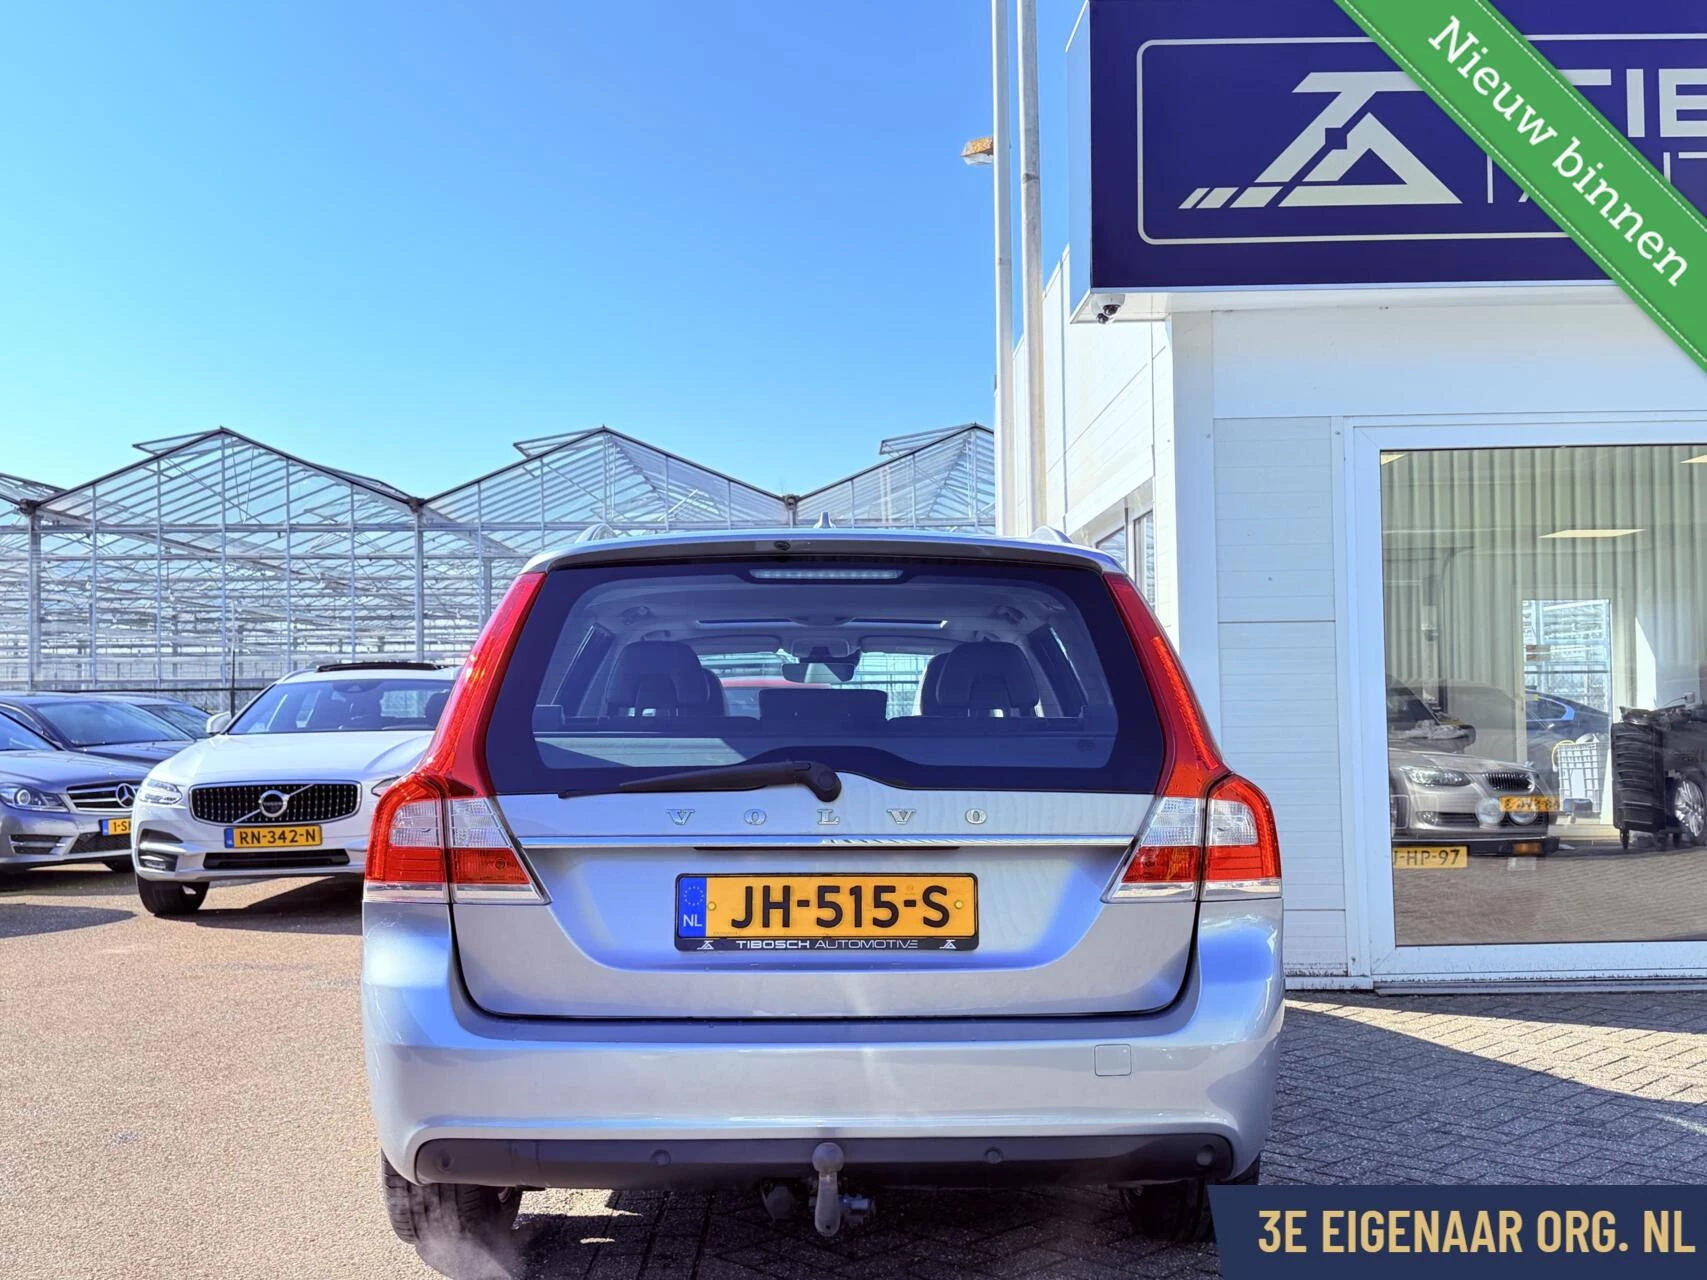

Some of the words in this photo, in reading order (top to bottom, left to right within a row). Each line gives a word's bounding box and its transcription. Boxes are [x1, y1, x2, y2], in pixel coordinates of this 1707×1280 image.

[666, 808, 988, 826] VOLVO
[239, 828, 316, 845] RN-342-N
[731, 885, 950, 928] JH-515-S
[683, 913, 703, 927] NL
[736, 940, 810, 949] TIBOSCH
[814, 940, 918, 949] AUTOMOTIVE
